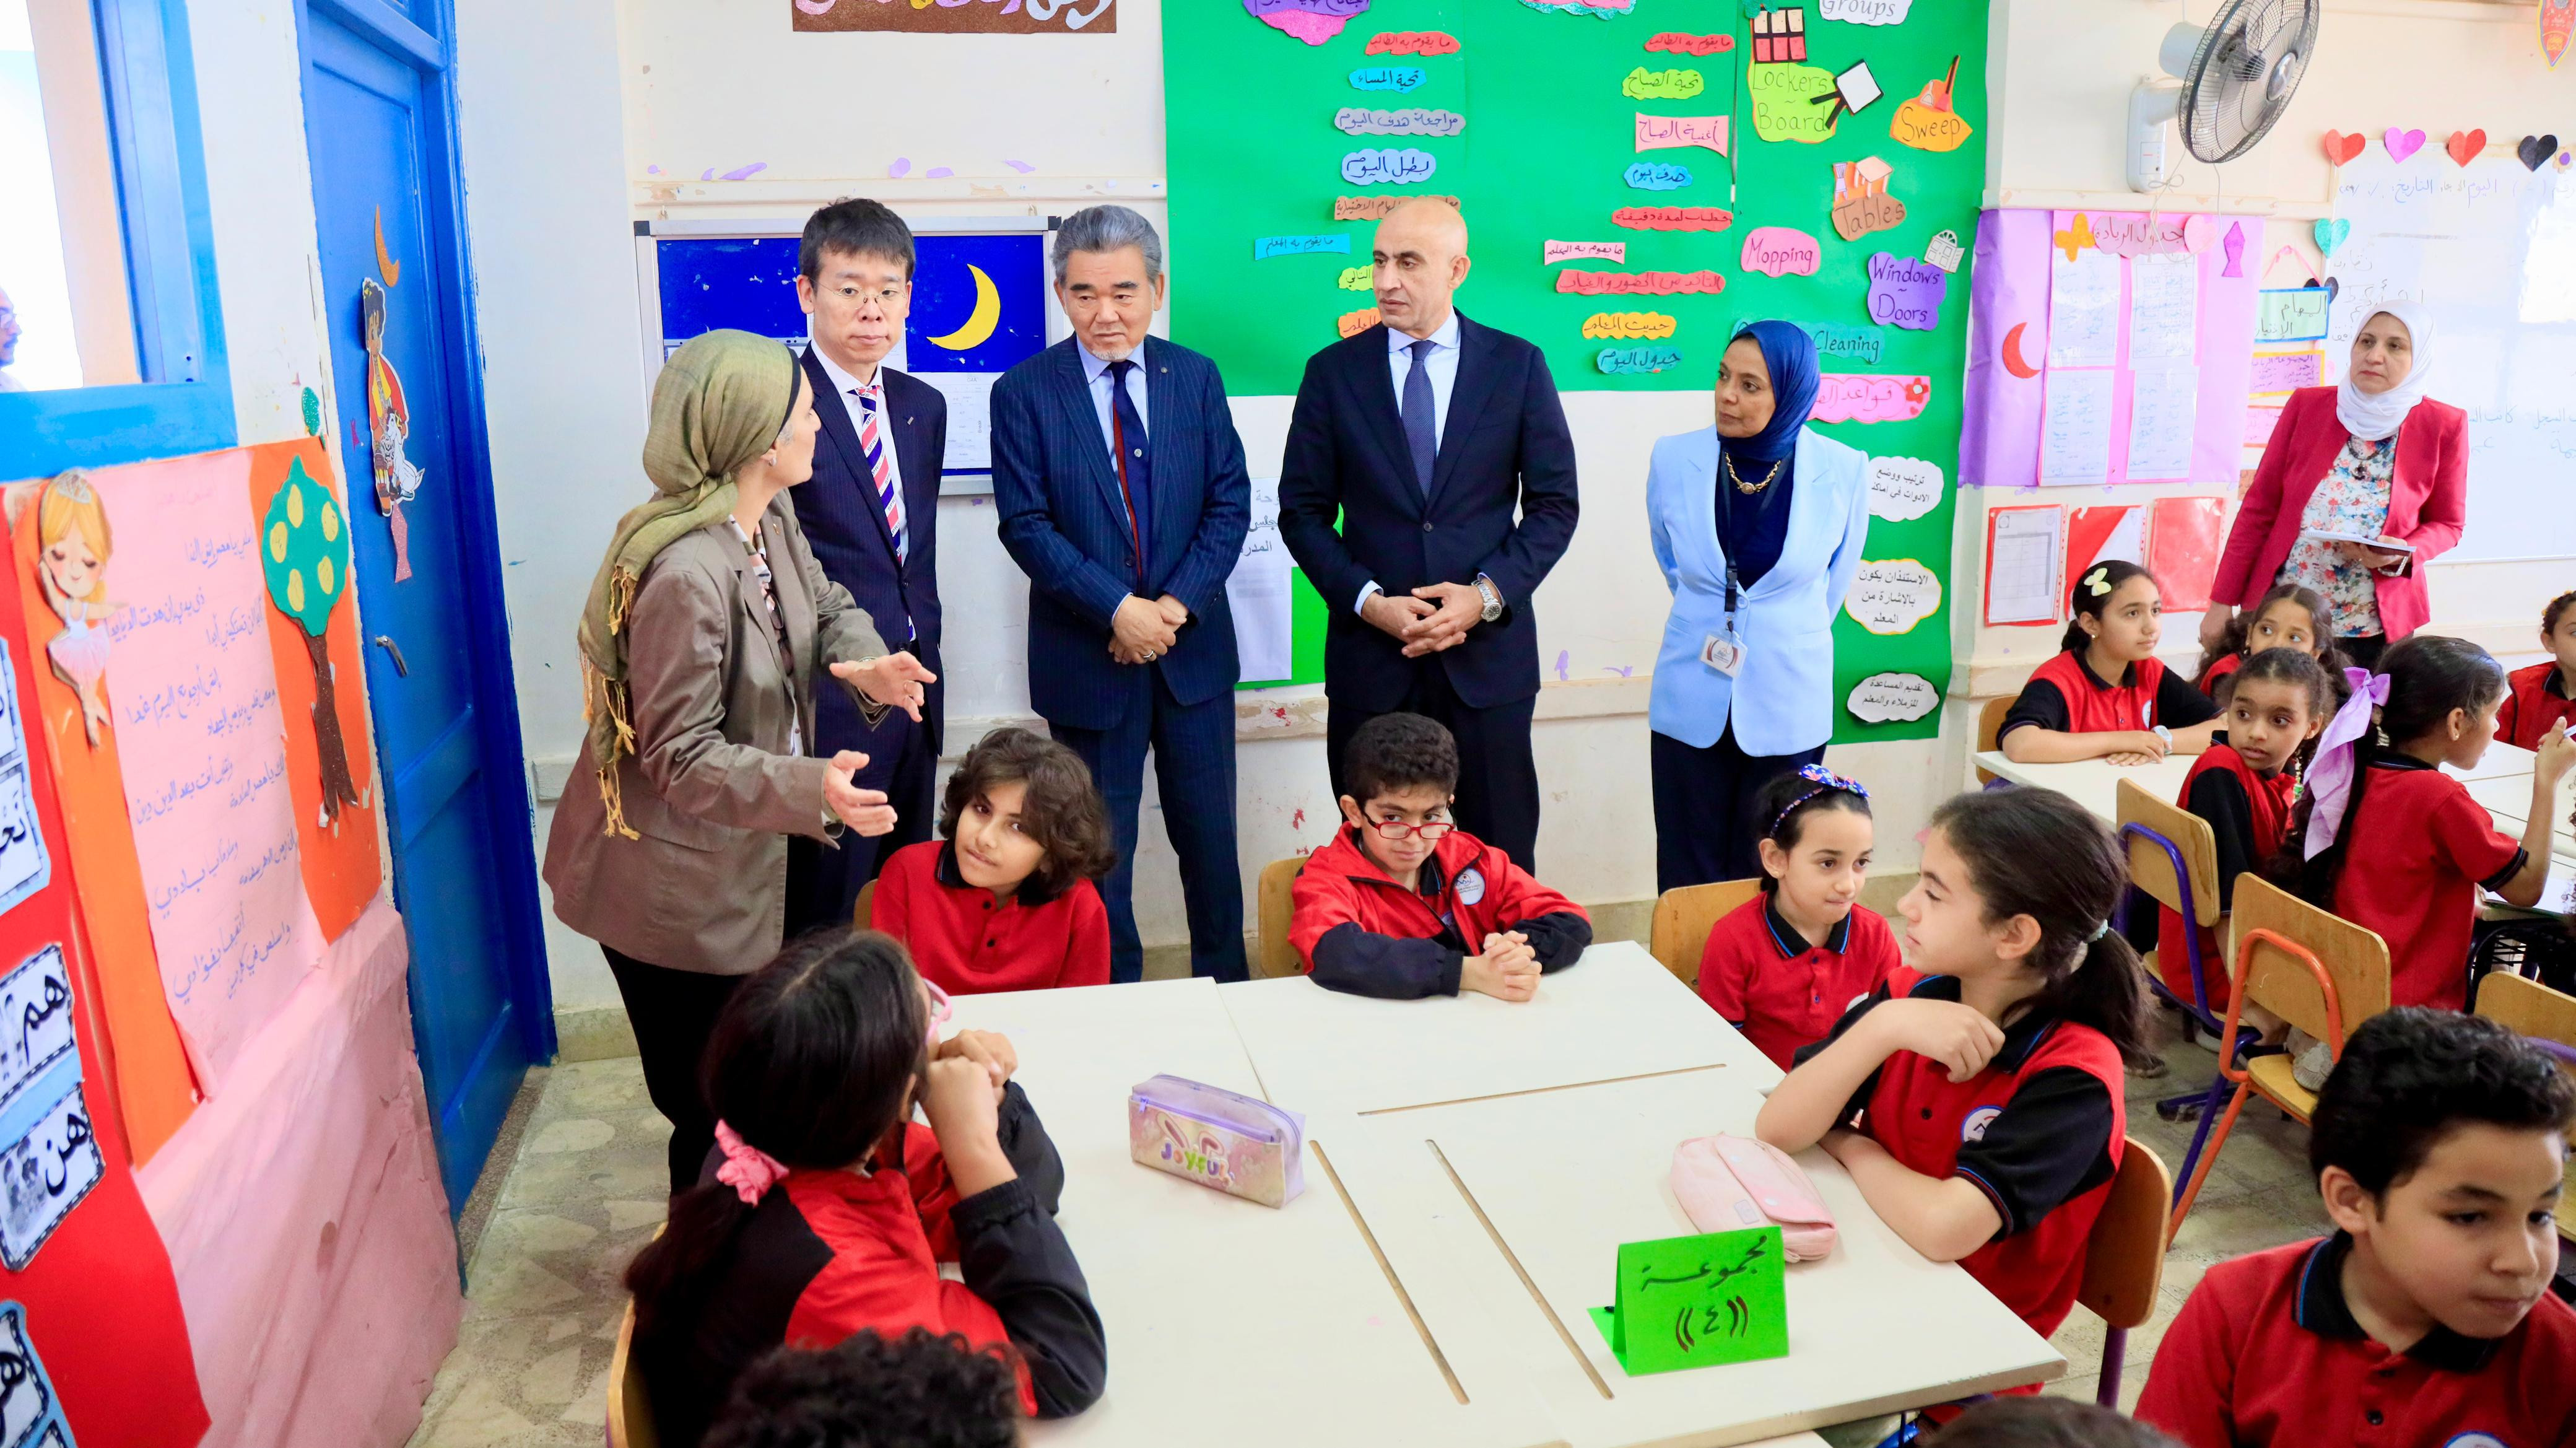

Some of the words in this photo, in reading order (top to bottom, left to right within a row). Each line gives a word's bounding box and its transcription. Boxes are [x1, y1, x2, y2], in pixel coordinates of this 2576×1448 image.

[1358, 70, 1393, 85] المساء
[1396, 70, 1419, 90] تحية
[1627, 73, 1669, 95] الصباح
[1675, 72, 1699, 90] تحية
[1752, 63, 1828, 94] Lockers
[1339, 112, 1373, 129] اليوم
[1377, 115, 1410, 128] هدف
[1757, 103, 1827, 133] Board
[1901, 106, 1960, 148] Sweep
[1638, 118, 1681, 144] الصباح
[1346, 156, 1388, 177] اليوم
[1392, 157, 1430, 177] بطل
[1835, 199, 1905, 236] Tables
[1747, 237, 1814, 274] Mopping
[1873, 255, 1940, 286] Windows
[1876, 293, 1928, 323] Doors
[1814, 330, 1880, 363] Cleaning
[1601, 349, 1637, 372] اليوم
[1640, 351, 1682, 369] جدول
[1256, 489, 1280, 506] وحة
[1859, 569, 1882, 582] يكون
[1861, 591, 1876, 603] من
[1873, 611, 1899, 627] المعلم
[1869, 679, 1904, 689] المساعدة
[1904, 683, 1925, 694] تقديم
[22, 973, 67, 1065] هم
[44, 1111, 88, 1198] هن
[1641, 1234, 1767, 1293] مجموعة
